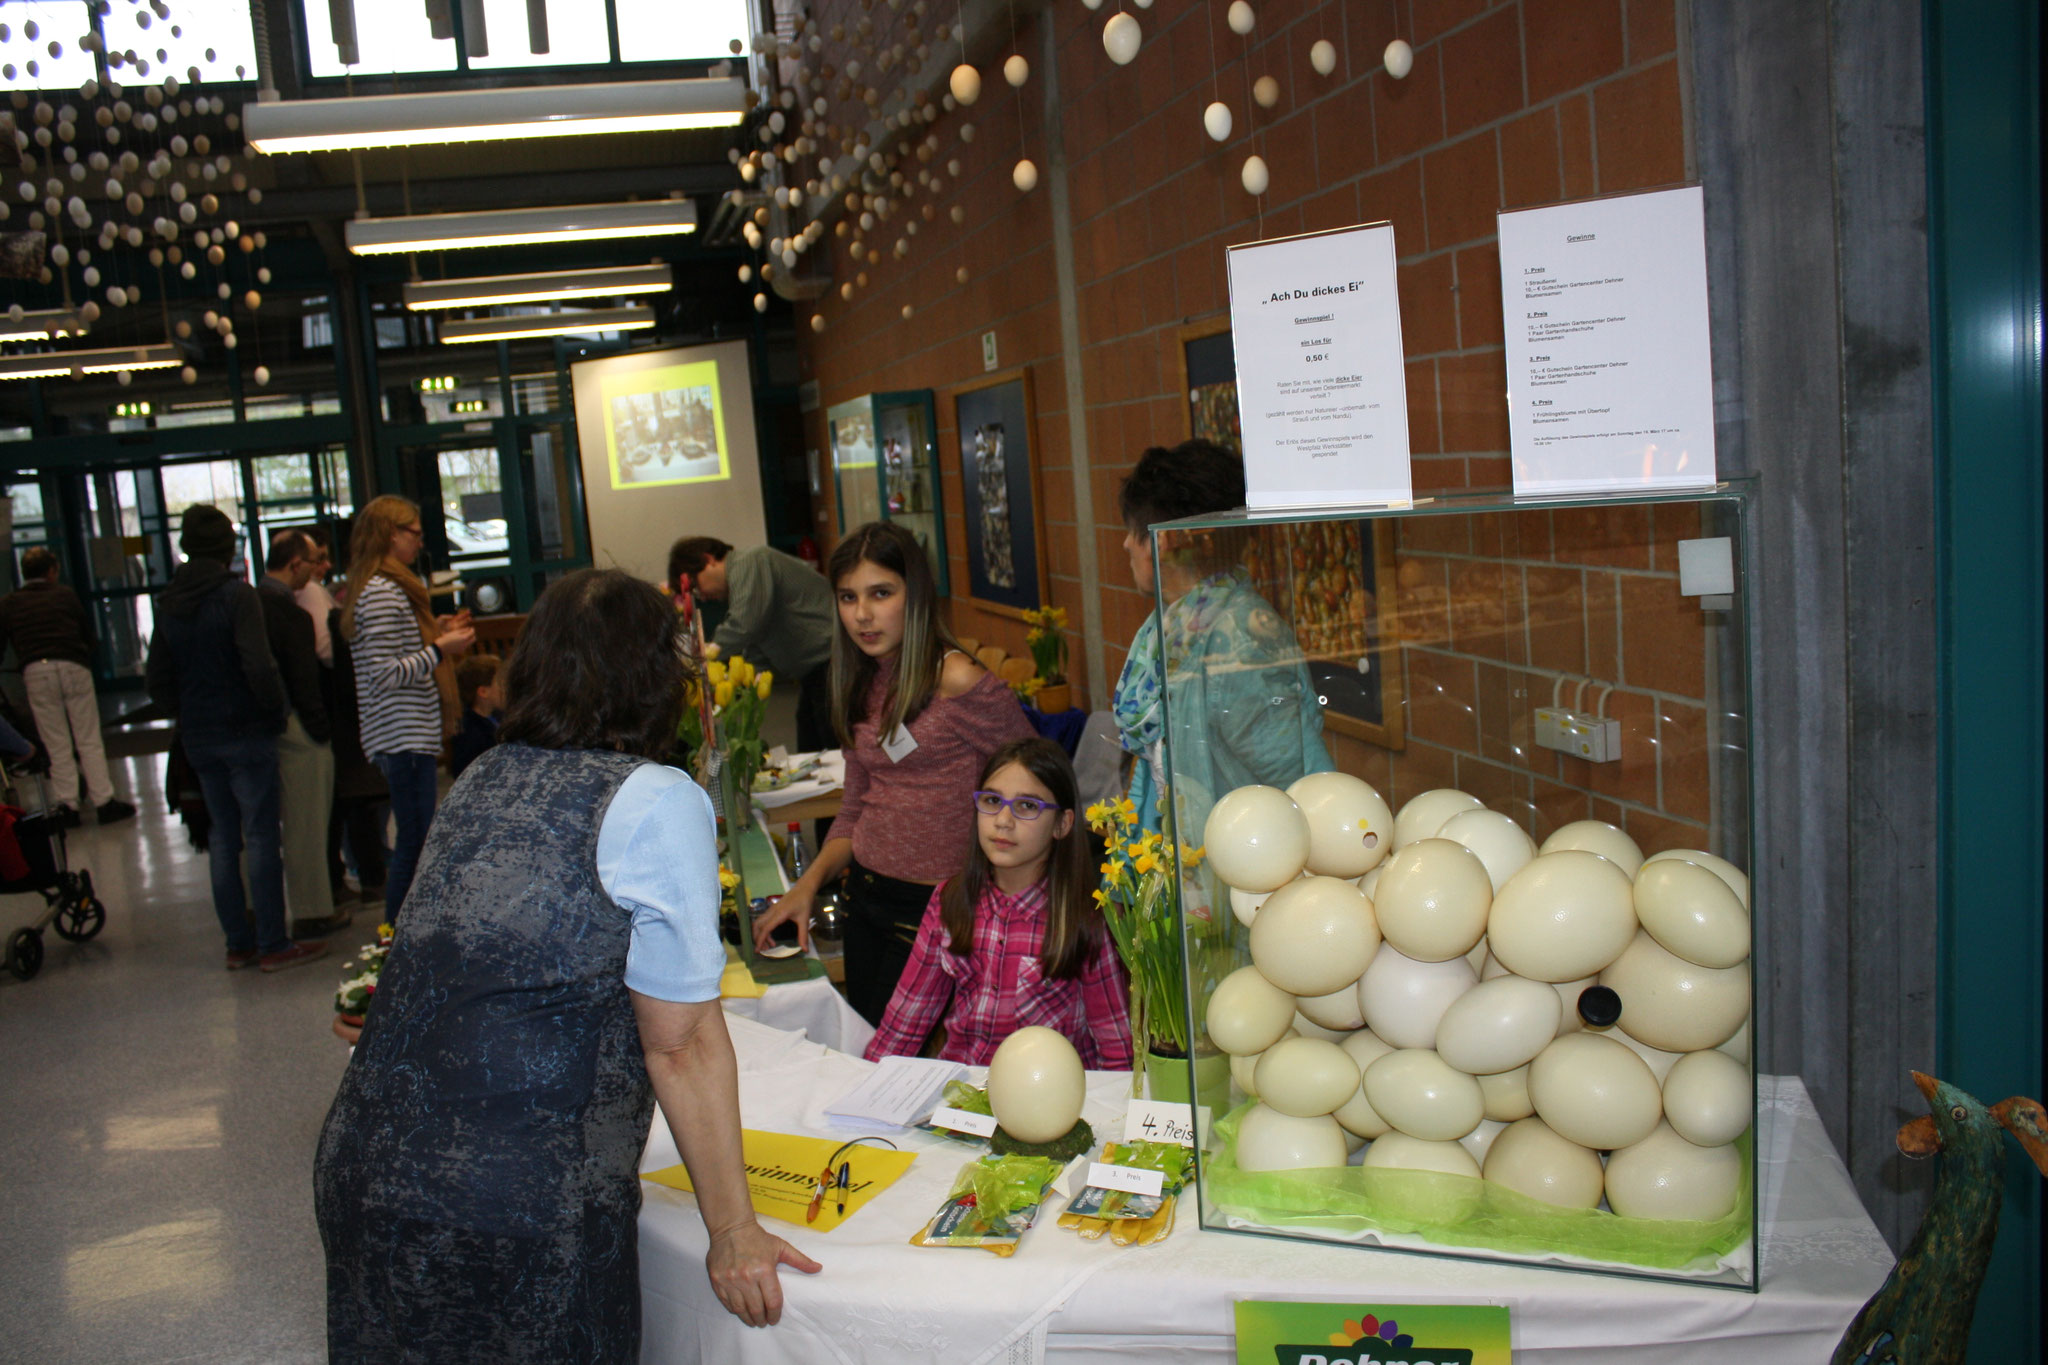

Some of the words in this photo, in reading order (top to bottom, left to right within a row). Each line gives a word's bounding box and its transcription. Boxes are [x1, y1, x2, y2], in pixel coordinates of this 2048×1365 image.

[1566, 233, 1596, 244] Gewinne
[1569, 280, 1604, 288] Gartencenter
[1270, 290, 1291, 303] Ach
[1294, 289, 1309, 300] Du
[1311, 285, 1346, 297] dickes
[1525, 291, 1562, 299] Blumensamen
[1294, 314, 1331, 325] Gewinnspiel
[1545, 326, 1594, 335] Gartenhandschuhe
[1322, 337, 1332, 345] für
[1305, 354, 1323, 363] 0,50
[1547, 370, 1597, 379] Gartenhandschuhe
[1530, 378, 1567, 387] Blumensamen
[1536, 410, 1577, 419] Frühlingsblume
[1587, 406, 1611, 415] Übertopf
[1142, 1113, 1158, 1136] 4.
[1163, 1120, 1194, 1140] Preis
[1126, 1172, 1142, 1182] Preis
